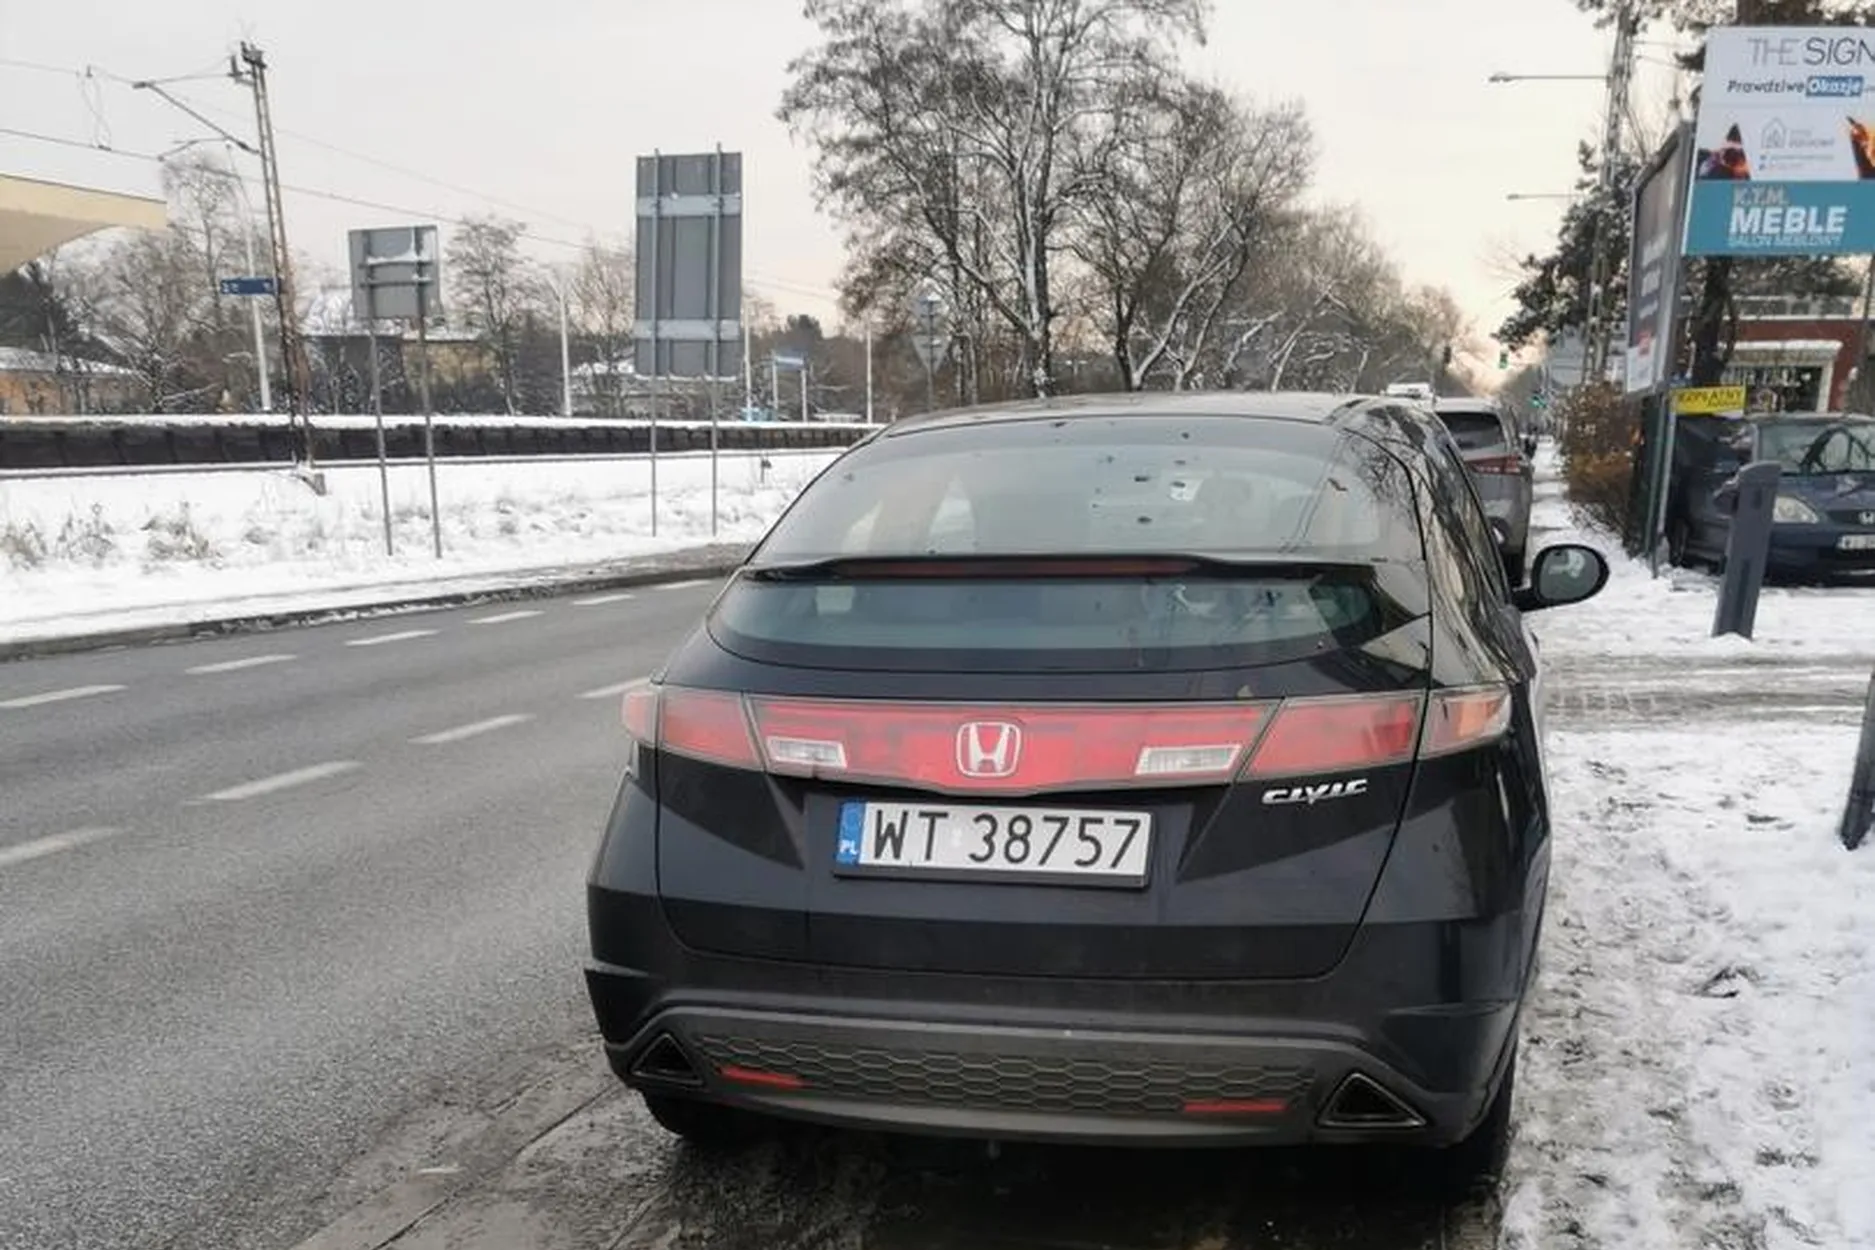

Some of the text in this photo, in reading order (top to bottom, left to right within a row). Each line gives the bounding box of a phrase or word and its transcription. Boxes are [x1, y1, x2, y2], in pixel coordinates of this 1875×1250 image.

[1748, 38, 1800, 66] THE
[1729, 205, 1847, 235] MEBLE
[1262, 778, 1368, 805] CIVIC
[873, 809, 1141, 869] WT 38757
